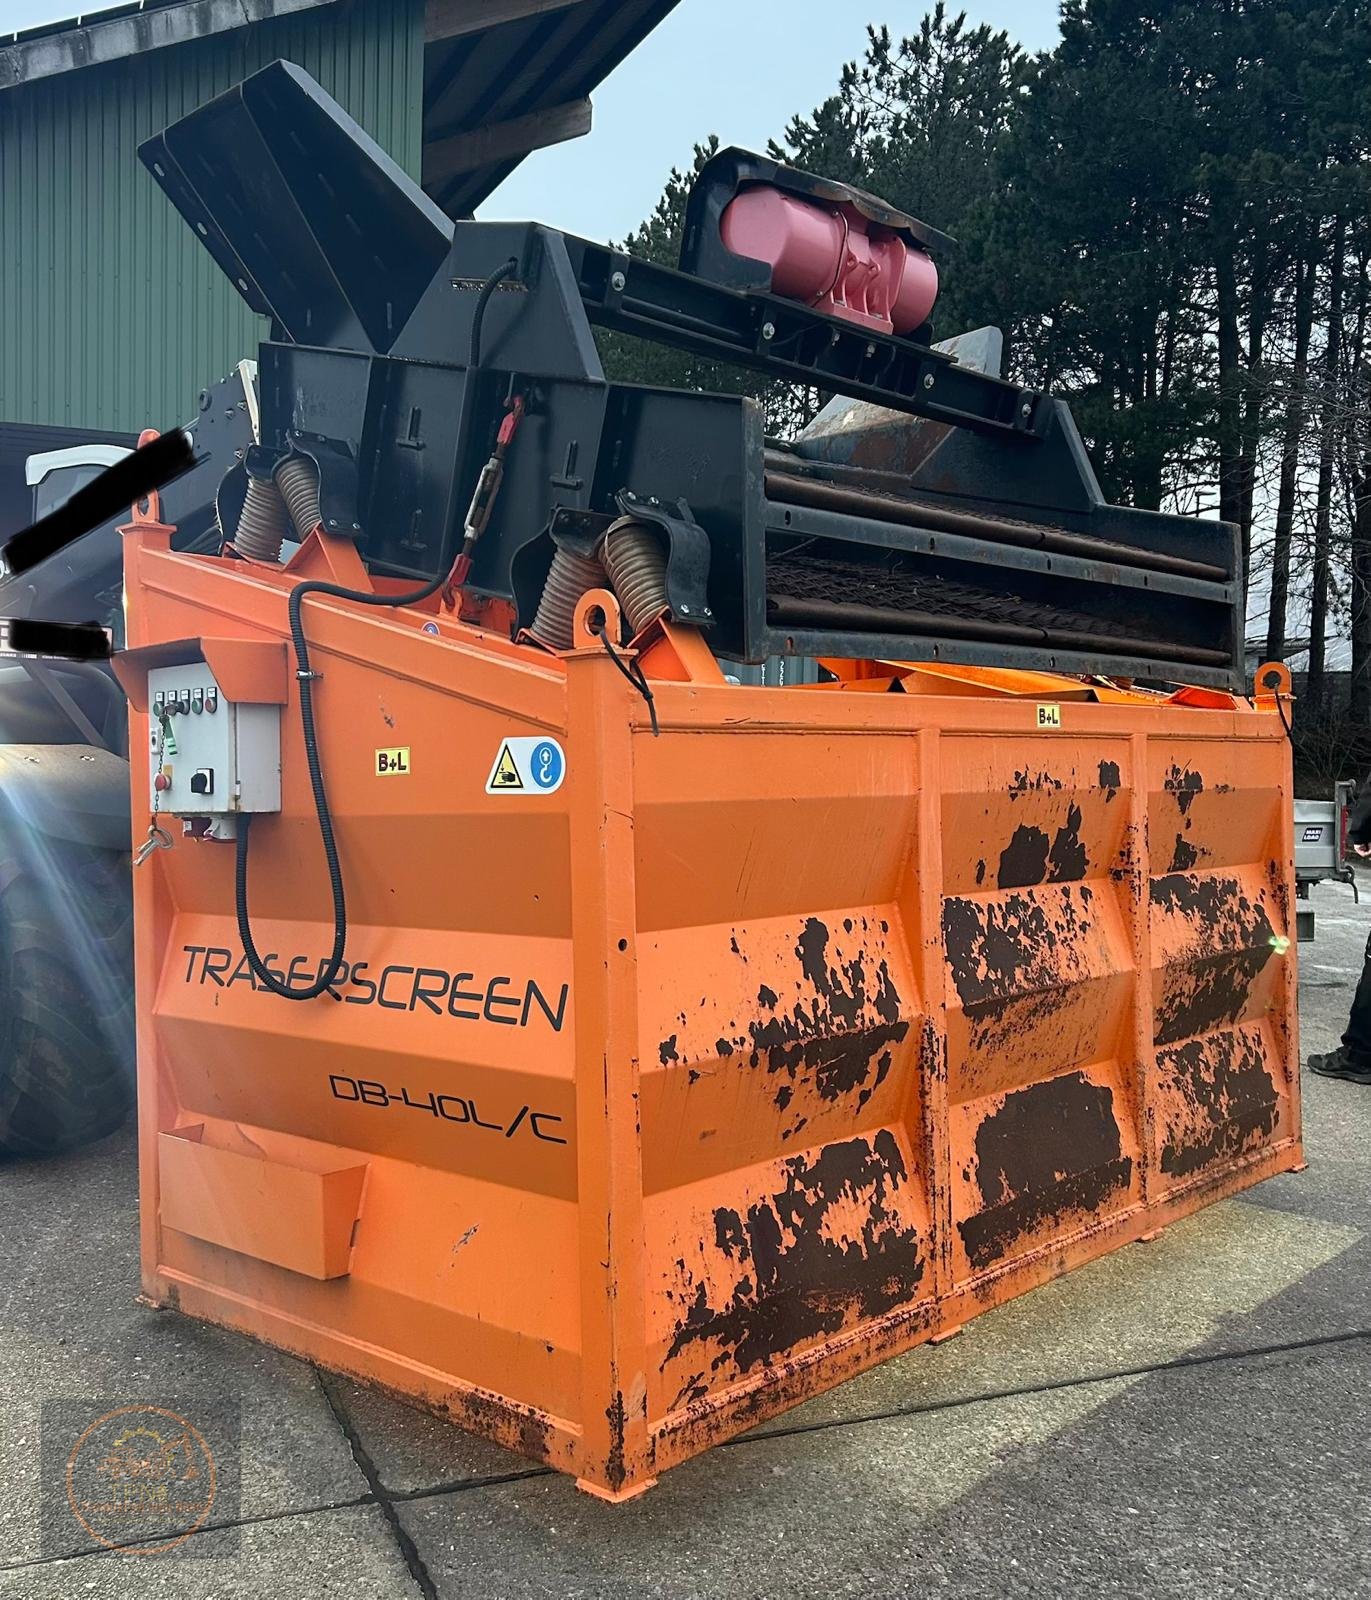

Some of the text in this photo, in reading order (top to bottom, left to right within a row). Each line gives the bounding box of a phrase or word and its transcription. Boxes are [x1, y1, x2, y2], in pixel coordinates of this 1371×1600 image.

[1039, 707, 1058, 724] B+L
[378, 751, 407, 772] B+L
[183, 945, 569, 1032] TRASERSCREEN
[328, 1074, 568, 1144] DB-40L/C
